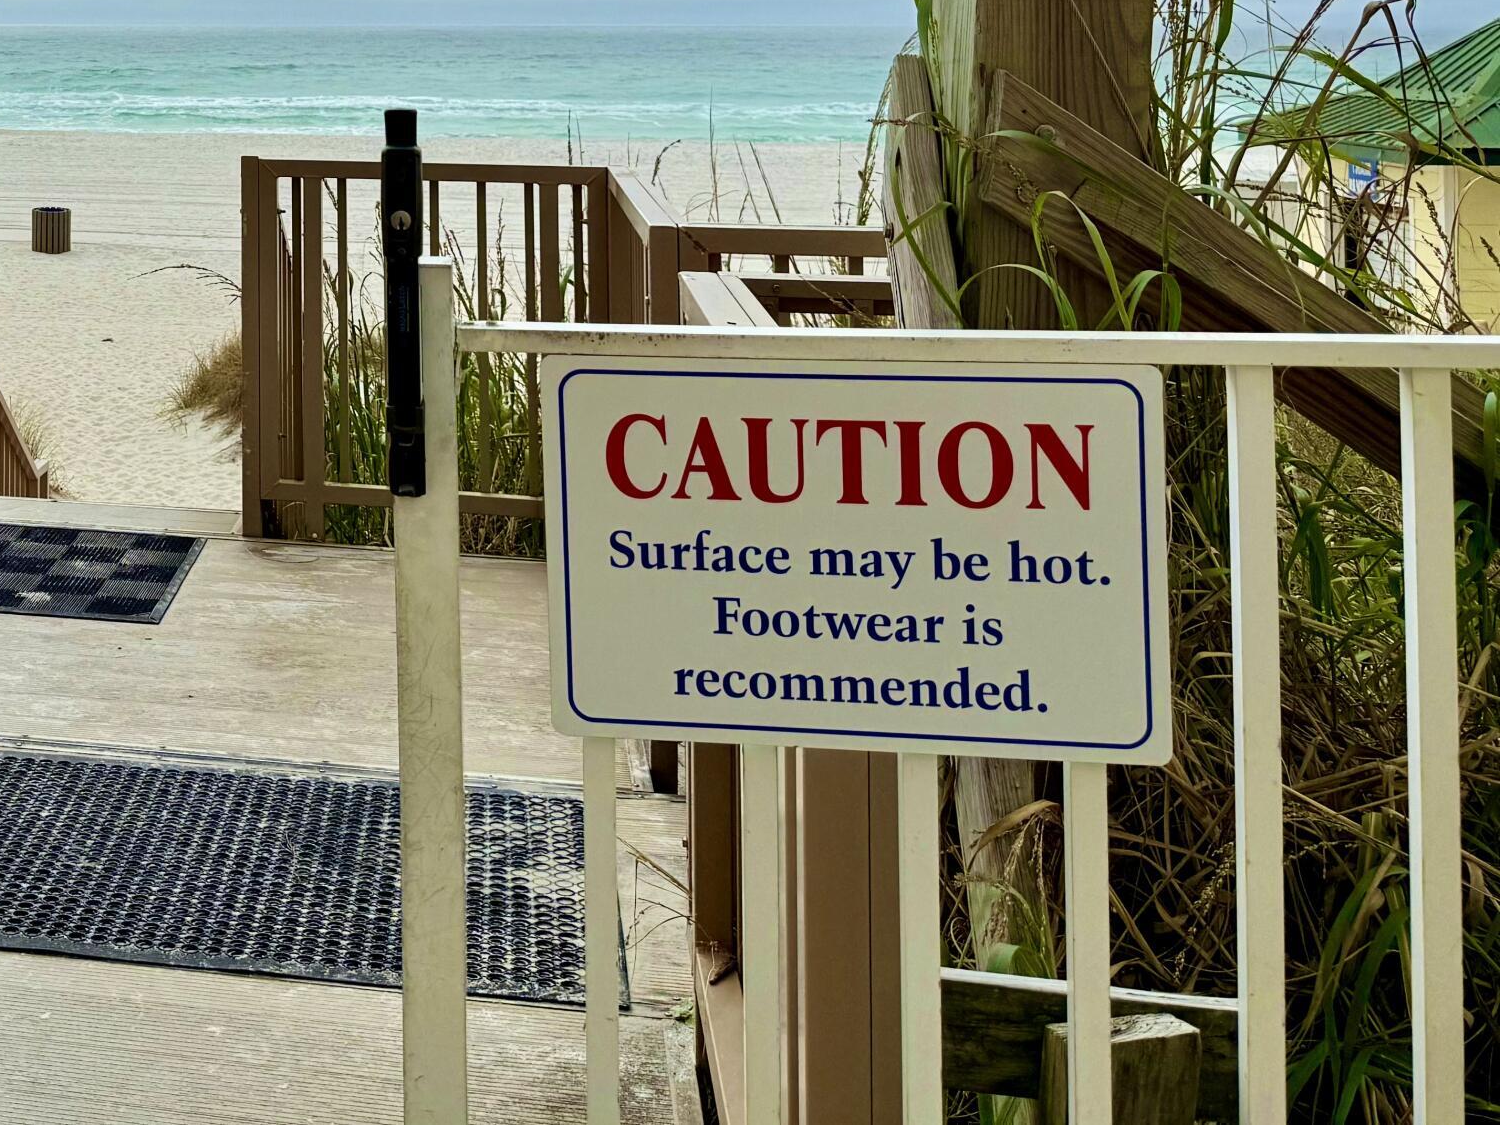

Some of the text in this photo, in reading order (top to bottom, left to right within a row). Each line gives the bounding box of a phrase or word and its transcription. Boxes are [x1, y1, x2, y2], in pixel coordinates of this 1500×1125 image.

[605, 413, 1095, 512] CAUTION
[609, 529, 1112, 591] Surface may be hot.
[713, 596, 1004, 647] Footwear is
[673, 666, 1049, 715] recommended.
